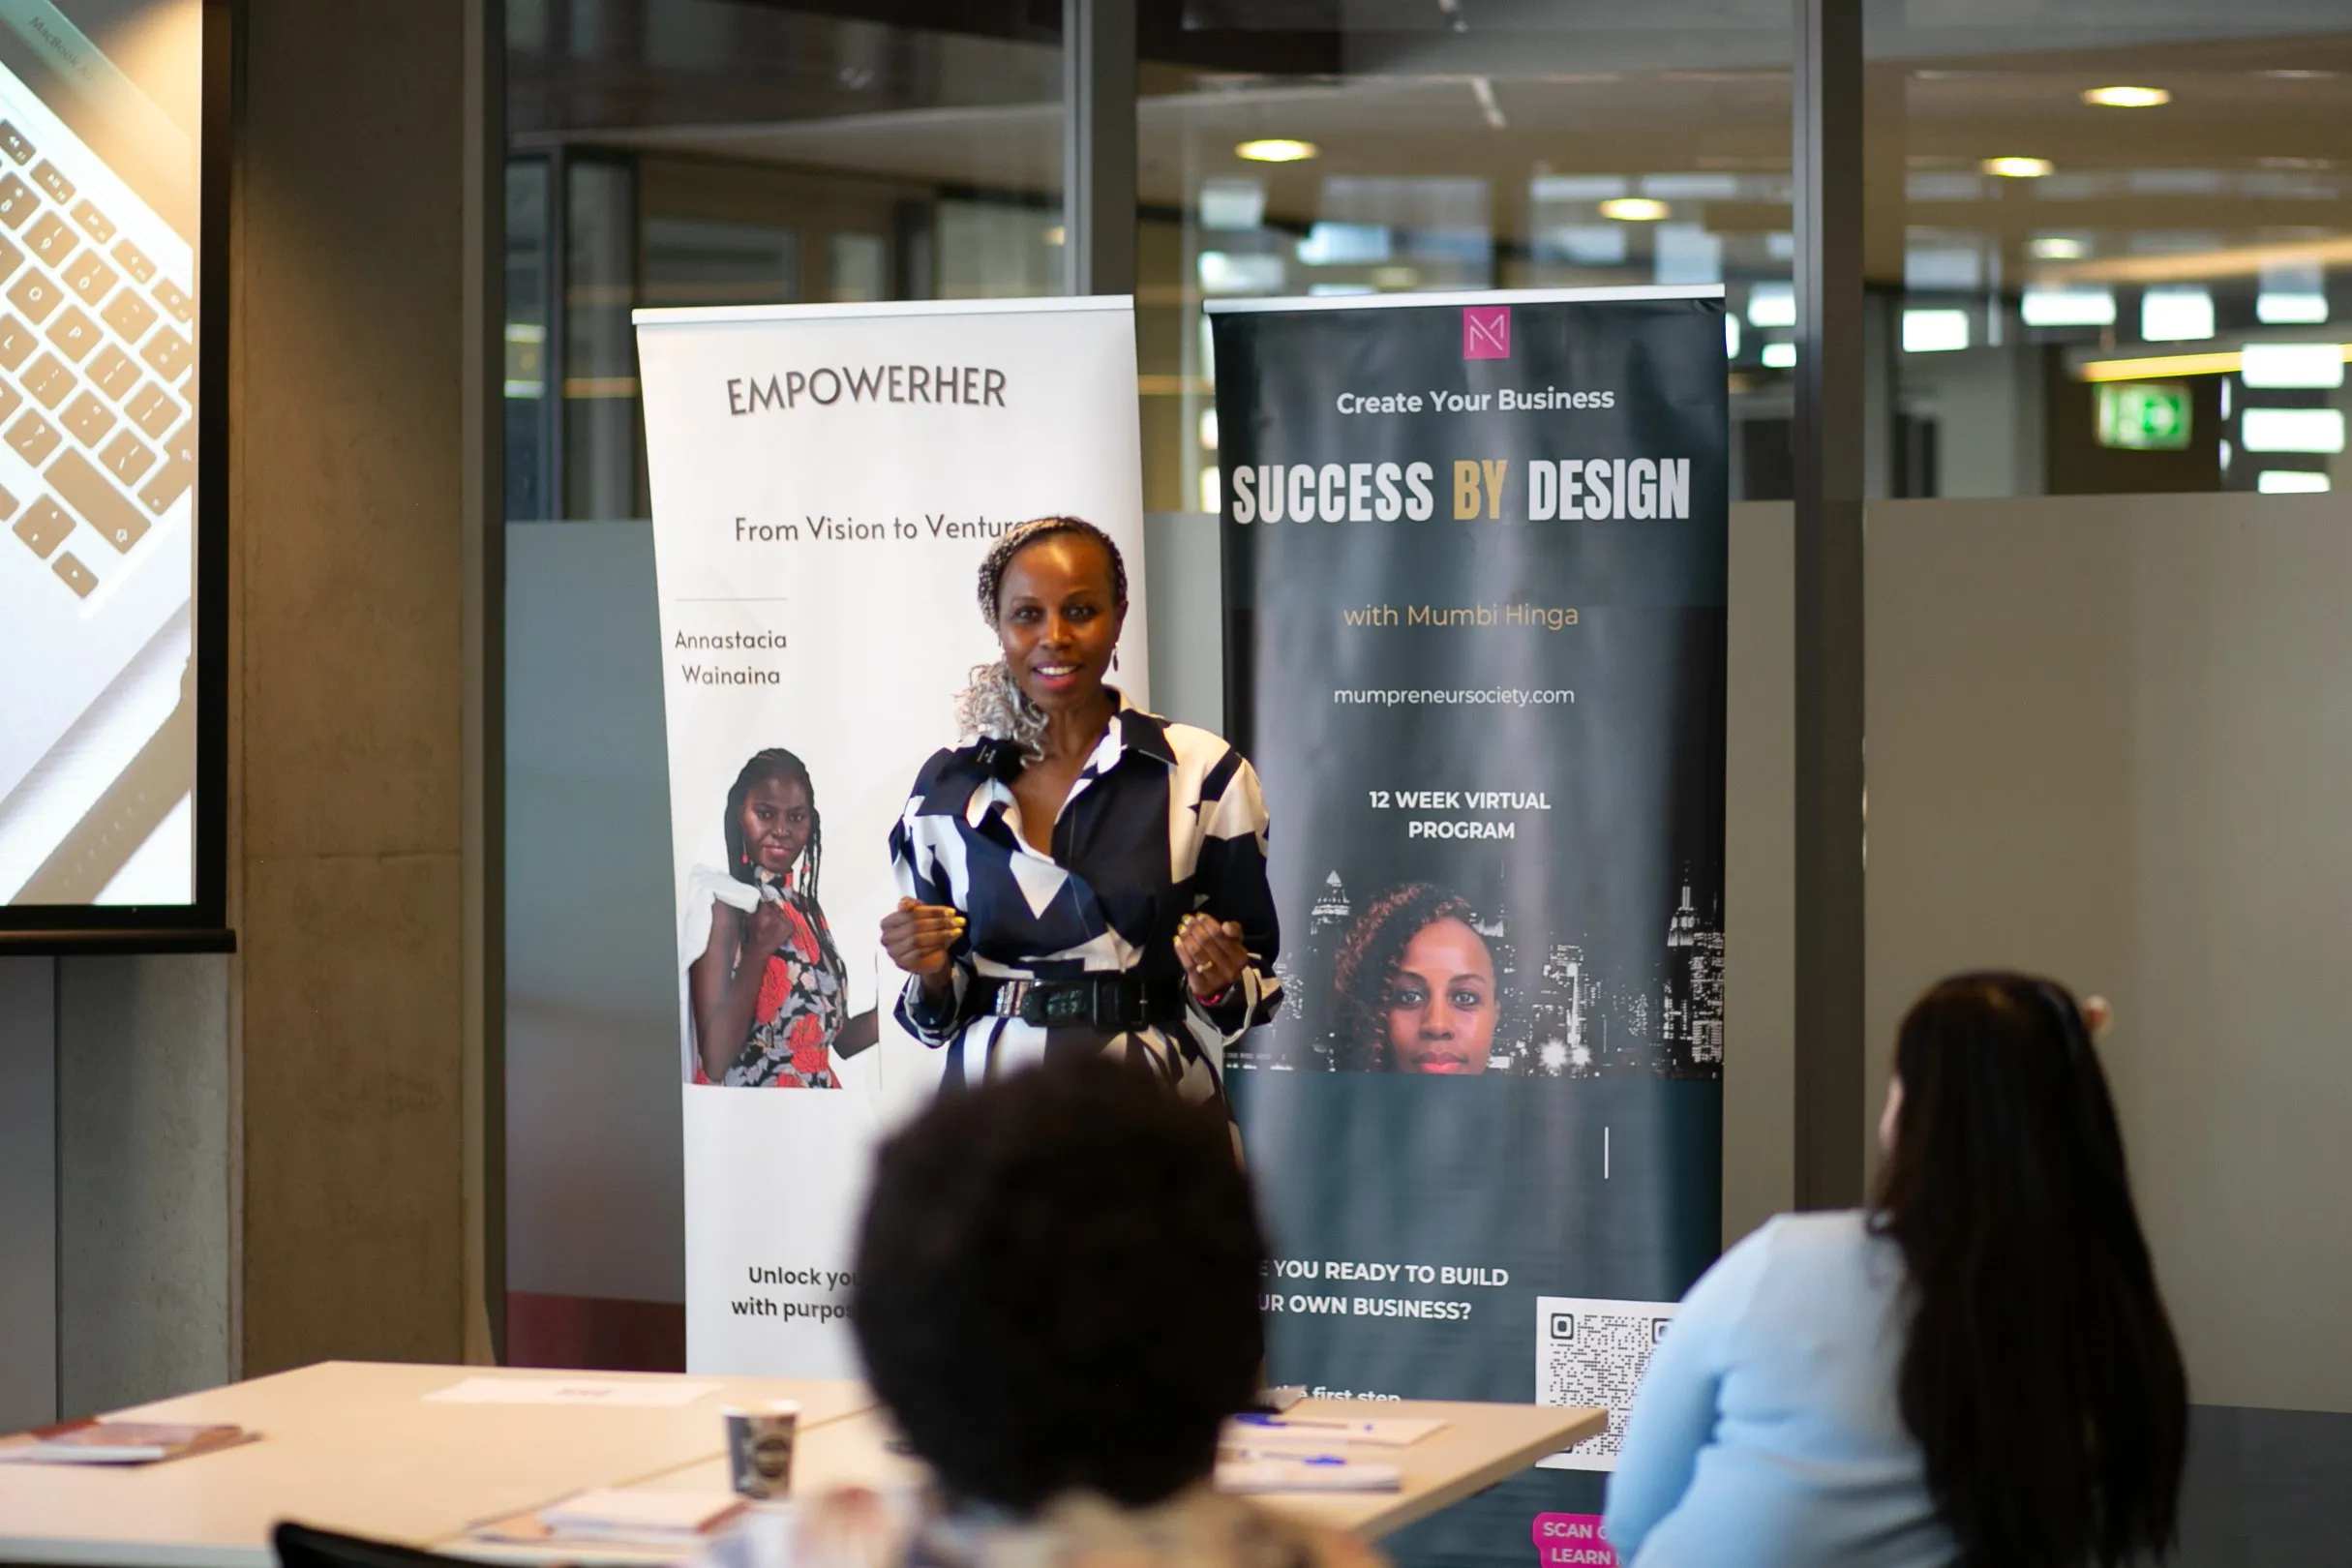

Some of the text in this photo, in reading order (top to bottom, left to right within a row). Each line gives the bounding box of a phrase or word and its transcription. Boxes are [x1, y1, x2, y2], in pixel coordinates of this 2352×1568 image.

[727, 365, 1008, 416] EMPOWERHER
[1337, 386, 1614, 414] Create Your Business
[1232, 458, 1690, 525] SUCCESS BY DESIGN
[736, 514, 1024, 541] From Vision to Ventur
[1343, 602, 1579, 630] with Mumbi Hinga
[675, 628, 787, 649] Annastacia
[681, 664, 780, 684] Wainaina
[1334, 686, 1575, 708] mumpreneursociety.com
[1369, 791, 1551, 809] 12 WEEK VIRTUAL
[1408, 821, 1515, 839] PROGRAM
[748, 1266, 822, 1285] Unlock
[1274, 1259, 1318, 1279] YOU
[1325, 1261, 1401, 1282] READY
[1404, 1265, 1435, 1283] TO
[1440, 1267, 1509, 1286] BUILD
[731, 1296, 777, 1316] with
[1289, 1294, 1347, 1314] OWN
[1353, 1298, 1472, 1320] BUSINESS?
[1542, 1522, 1593, 1539] SCAN
[1552, 1548, 1612, 1565] LEARN
